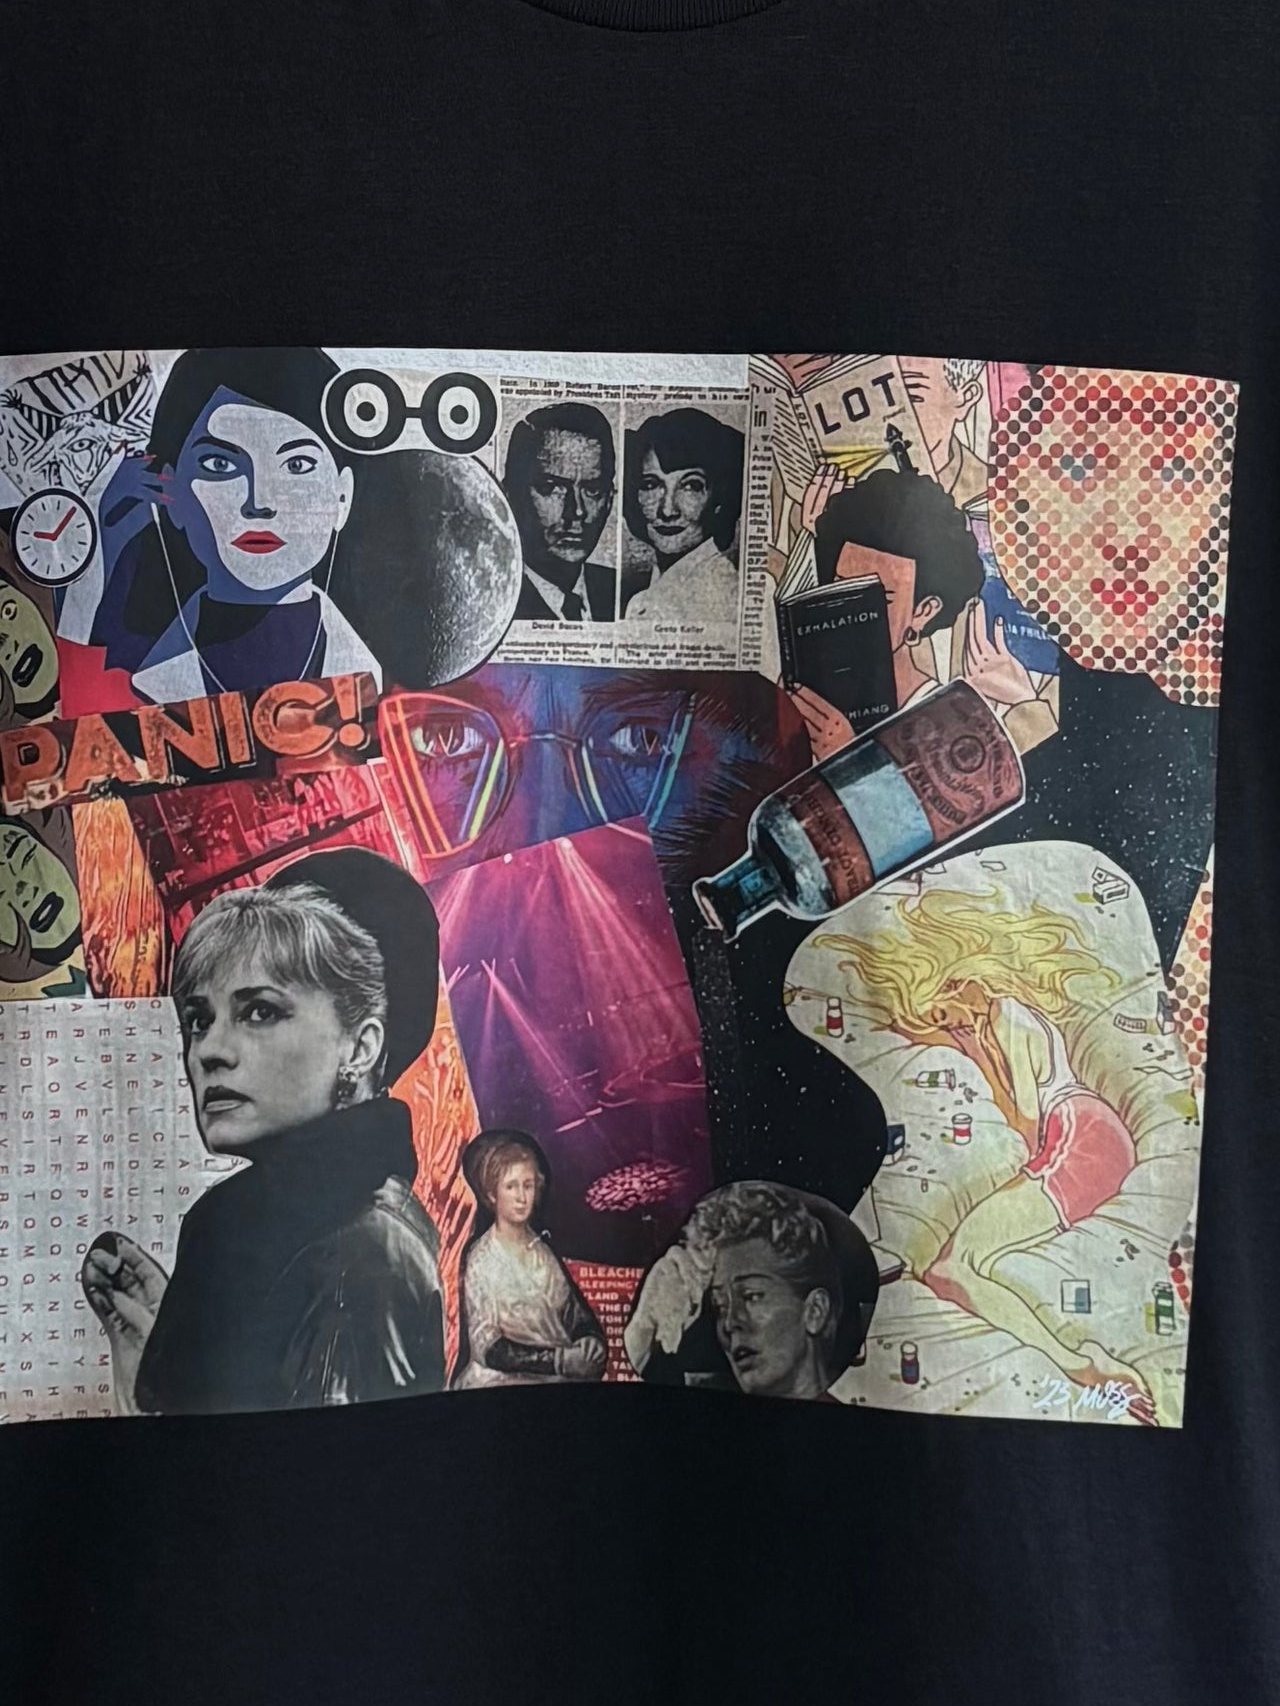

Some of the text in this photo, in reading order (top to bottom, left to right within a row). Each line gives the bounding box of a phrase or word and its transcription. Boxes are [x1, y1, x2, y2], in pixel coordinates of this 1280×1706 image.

[814, 371, 896, 435] LOT
[797, 612, 879, 636] EXHALATION
[0, 674, 370, 805] PANIC!
[598, 1303, 621, 1312] THE
